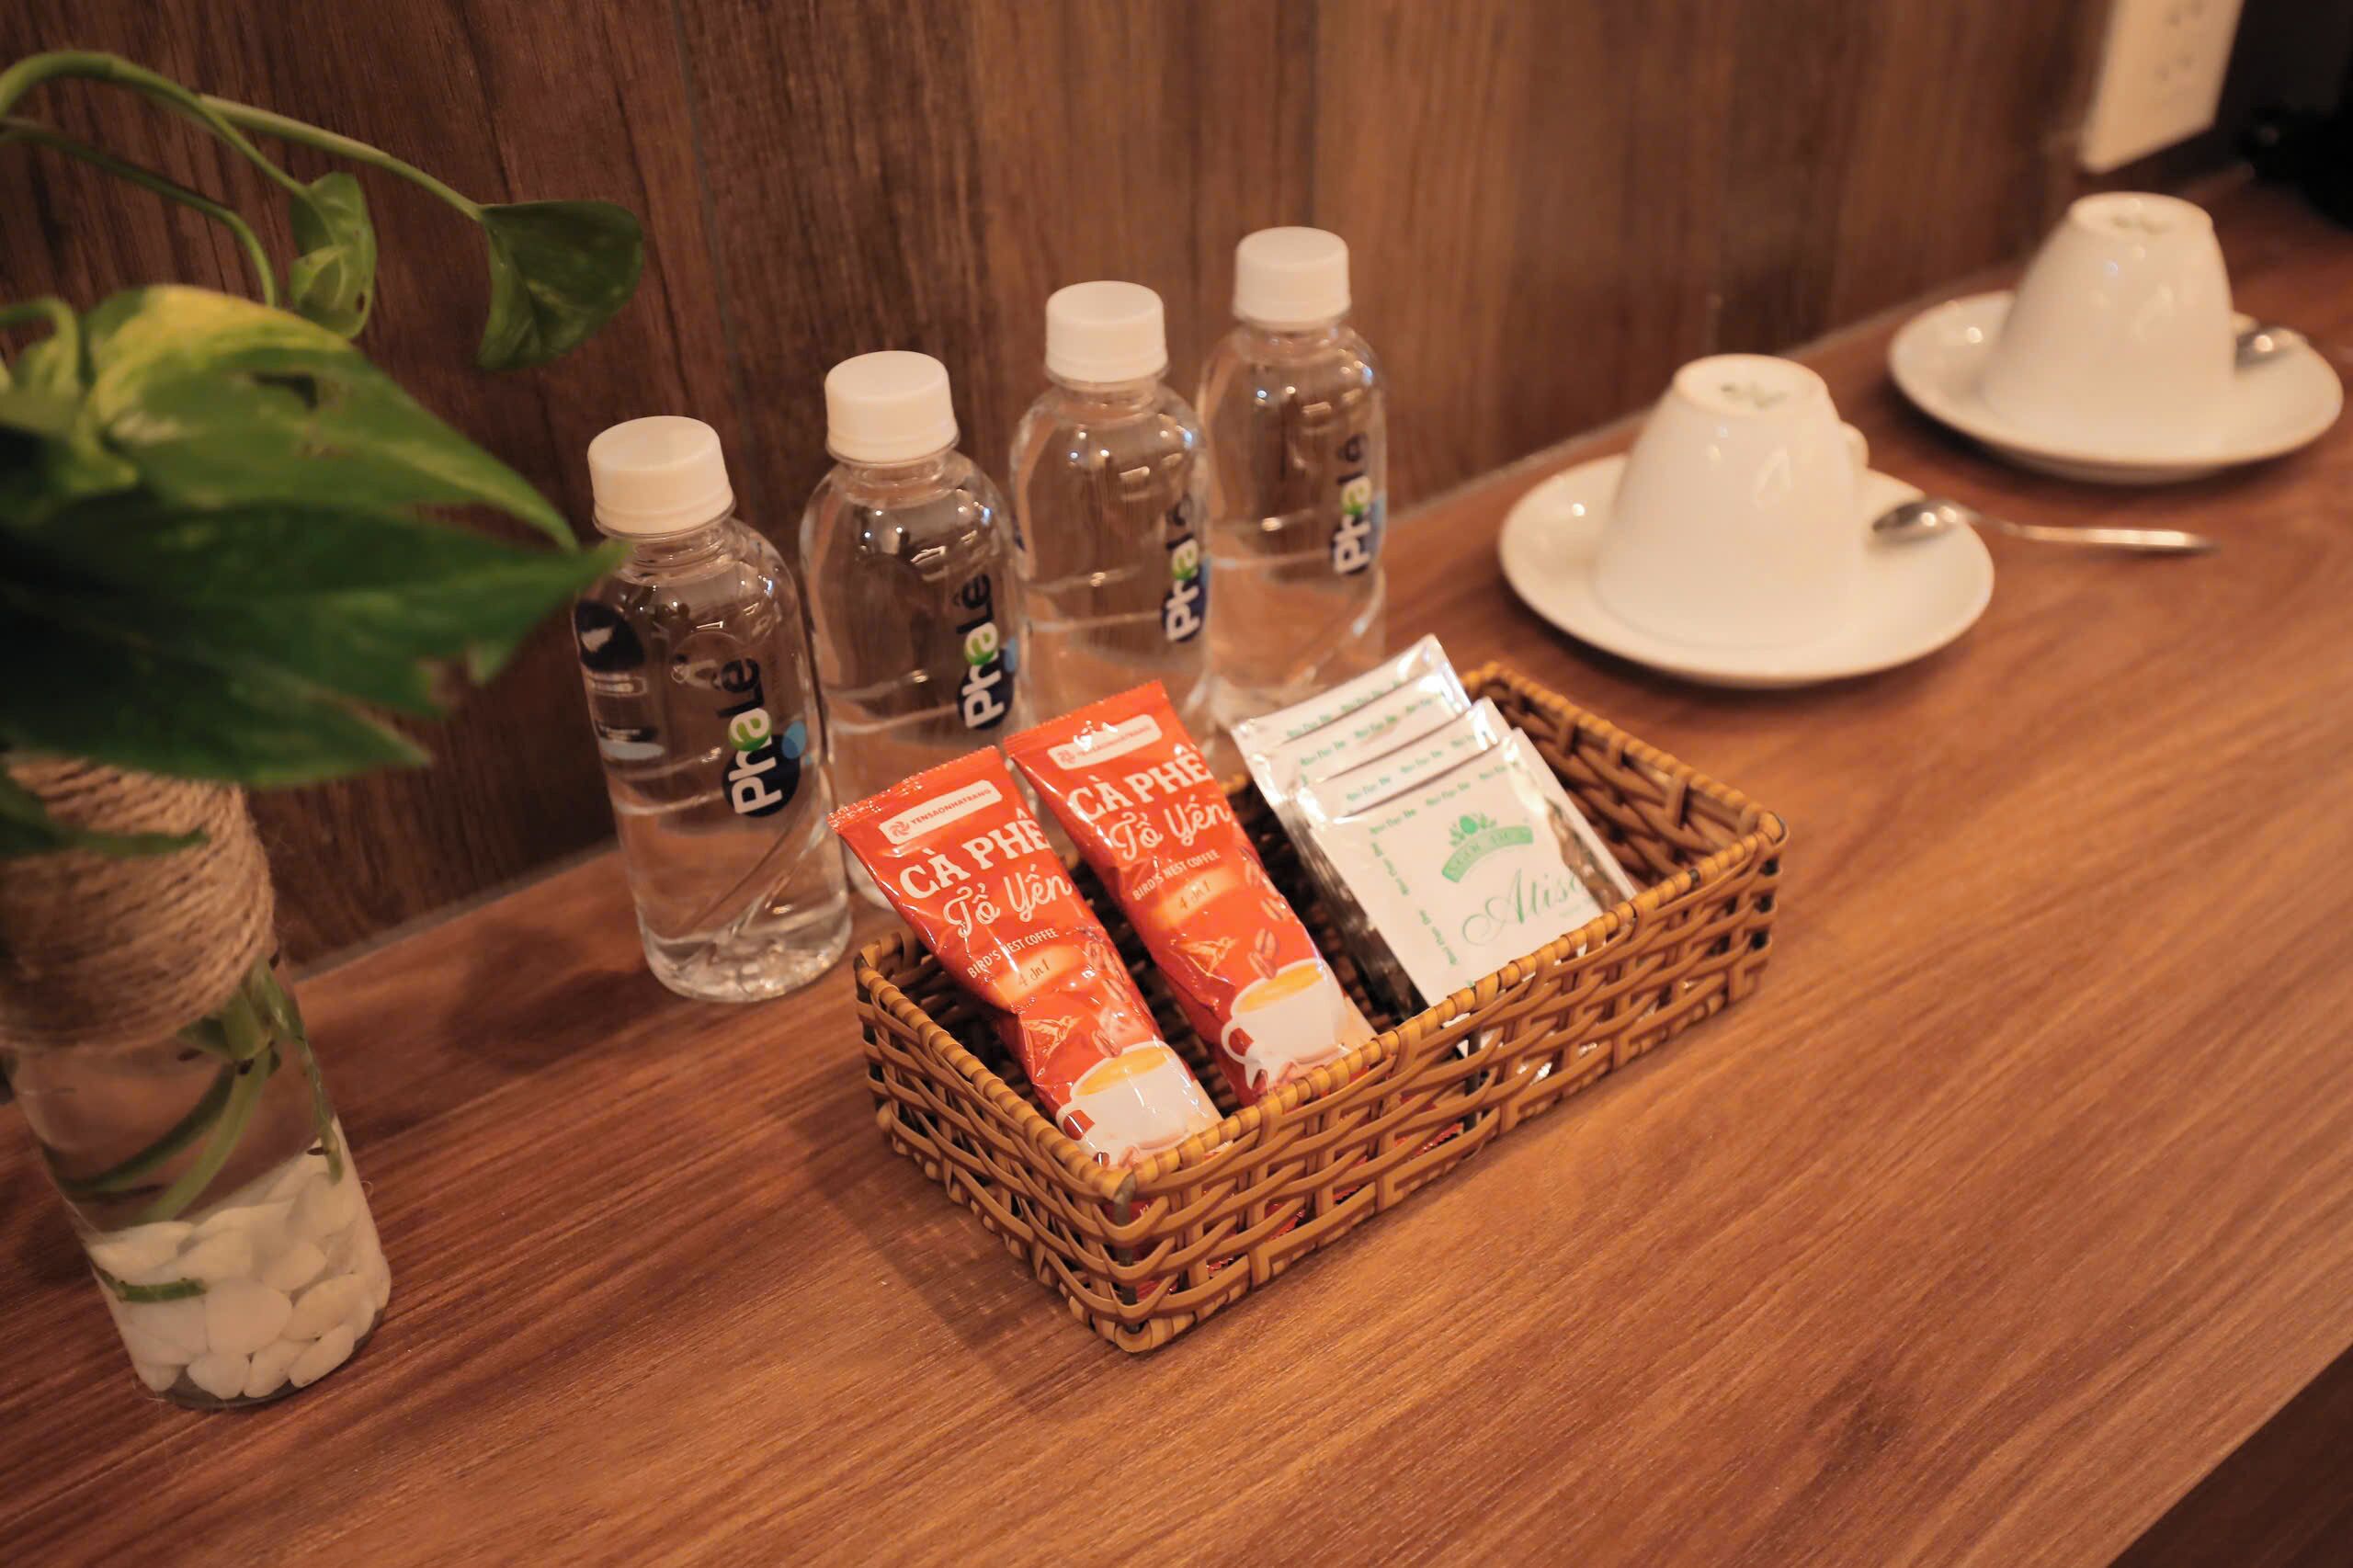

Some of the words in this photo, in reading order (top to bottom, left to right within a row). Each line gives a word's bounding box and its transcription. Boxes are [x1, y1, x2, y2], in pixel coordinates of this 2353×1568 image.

[1067, 775, 1134, 822] CÀ
[1123, 744, 1214, 803] PHÊ
[1164, 793, 1232, 846] Yến
[899, 847, 971, 899] CÀ
[961, 808, 1052, 869] PHÊ
[1131, 872, 1165, 901] BIRD'S
[1162, 860, 1188, 879] NEST
[1187, 849, 1221, 868] COFFEE
[942, 882, 1001, 937] Tổ
[1003, 863, 1073, 923] Yến
[967, 949, 1002, 979] BIRD'S
[1025, 927, 1060, 946] COFFEE
